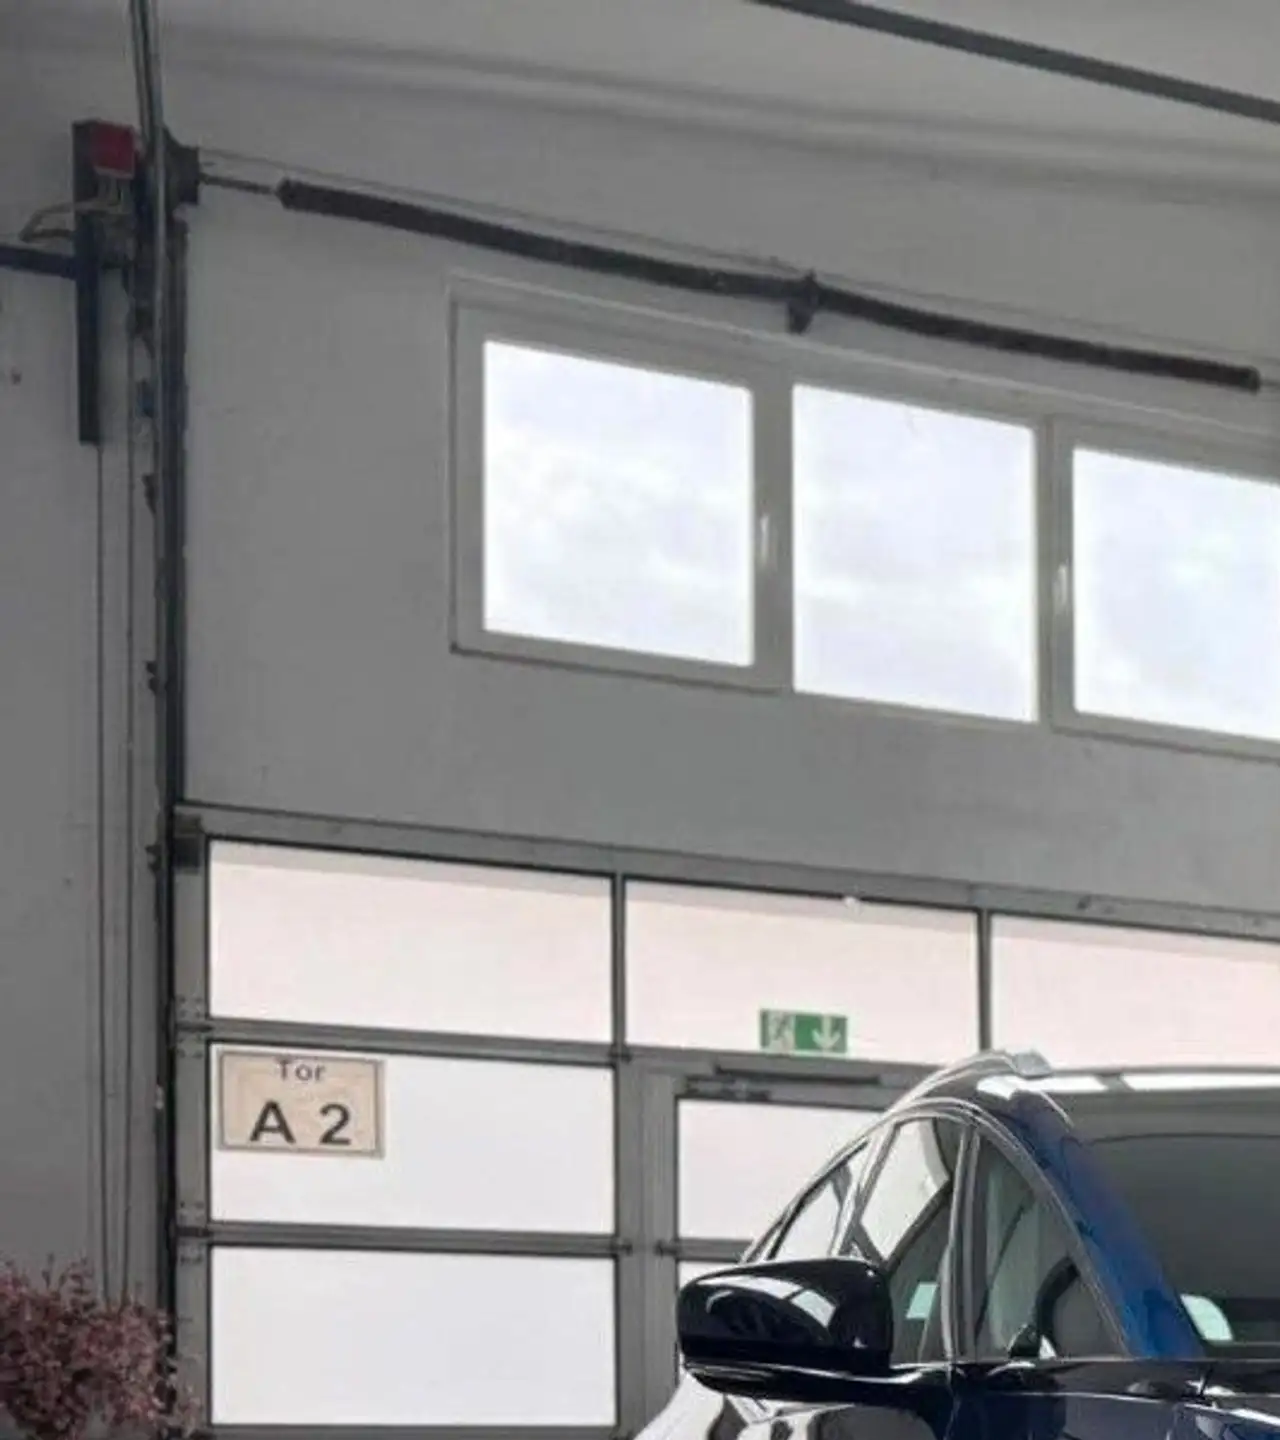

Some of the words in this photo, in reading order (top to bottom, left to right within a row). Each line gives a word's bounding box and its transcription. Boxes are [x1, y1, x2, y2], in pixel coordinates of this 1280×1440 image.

[274, 1056, 325, 1082] Tor
[249, 1099, 296, 1144] A
[319, 1103, 352, 1146] 2
